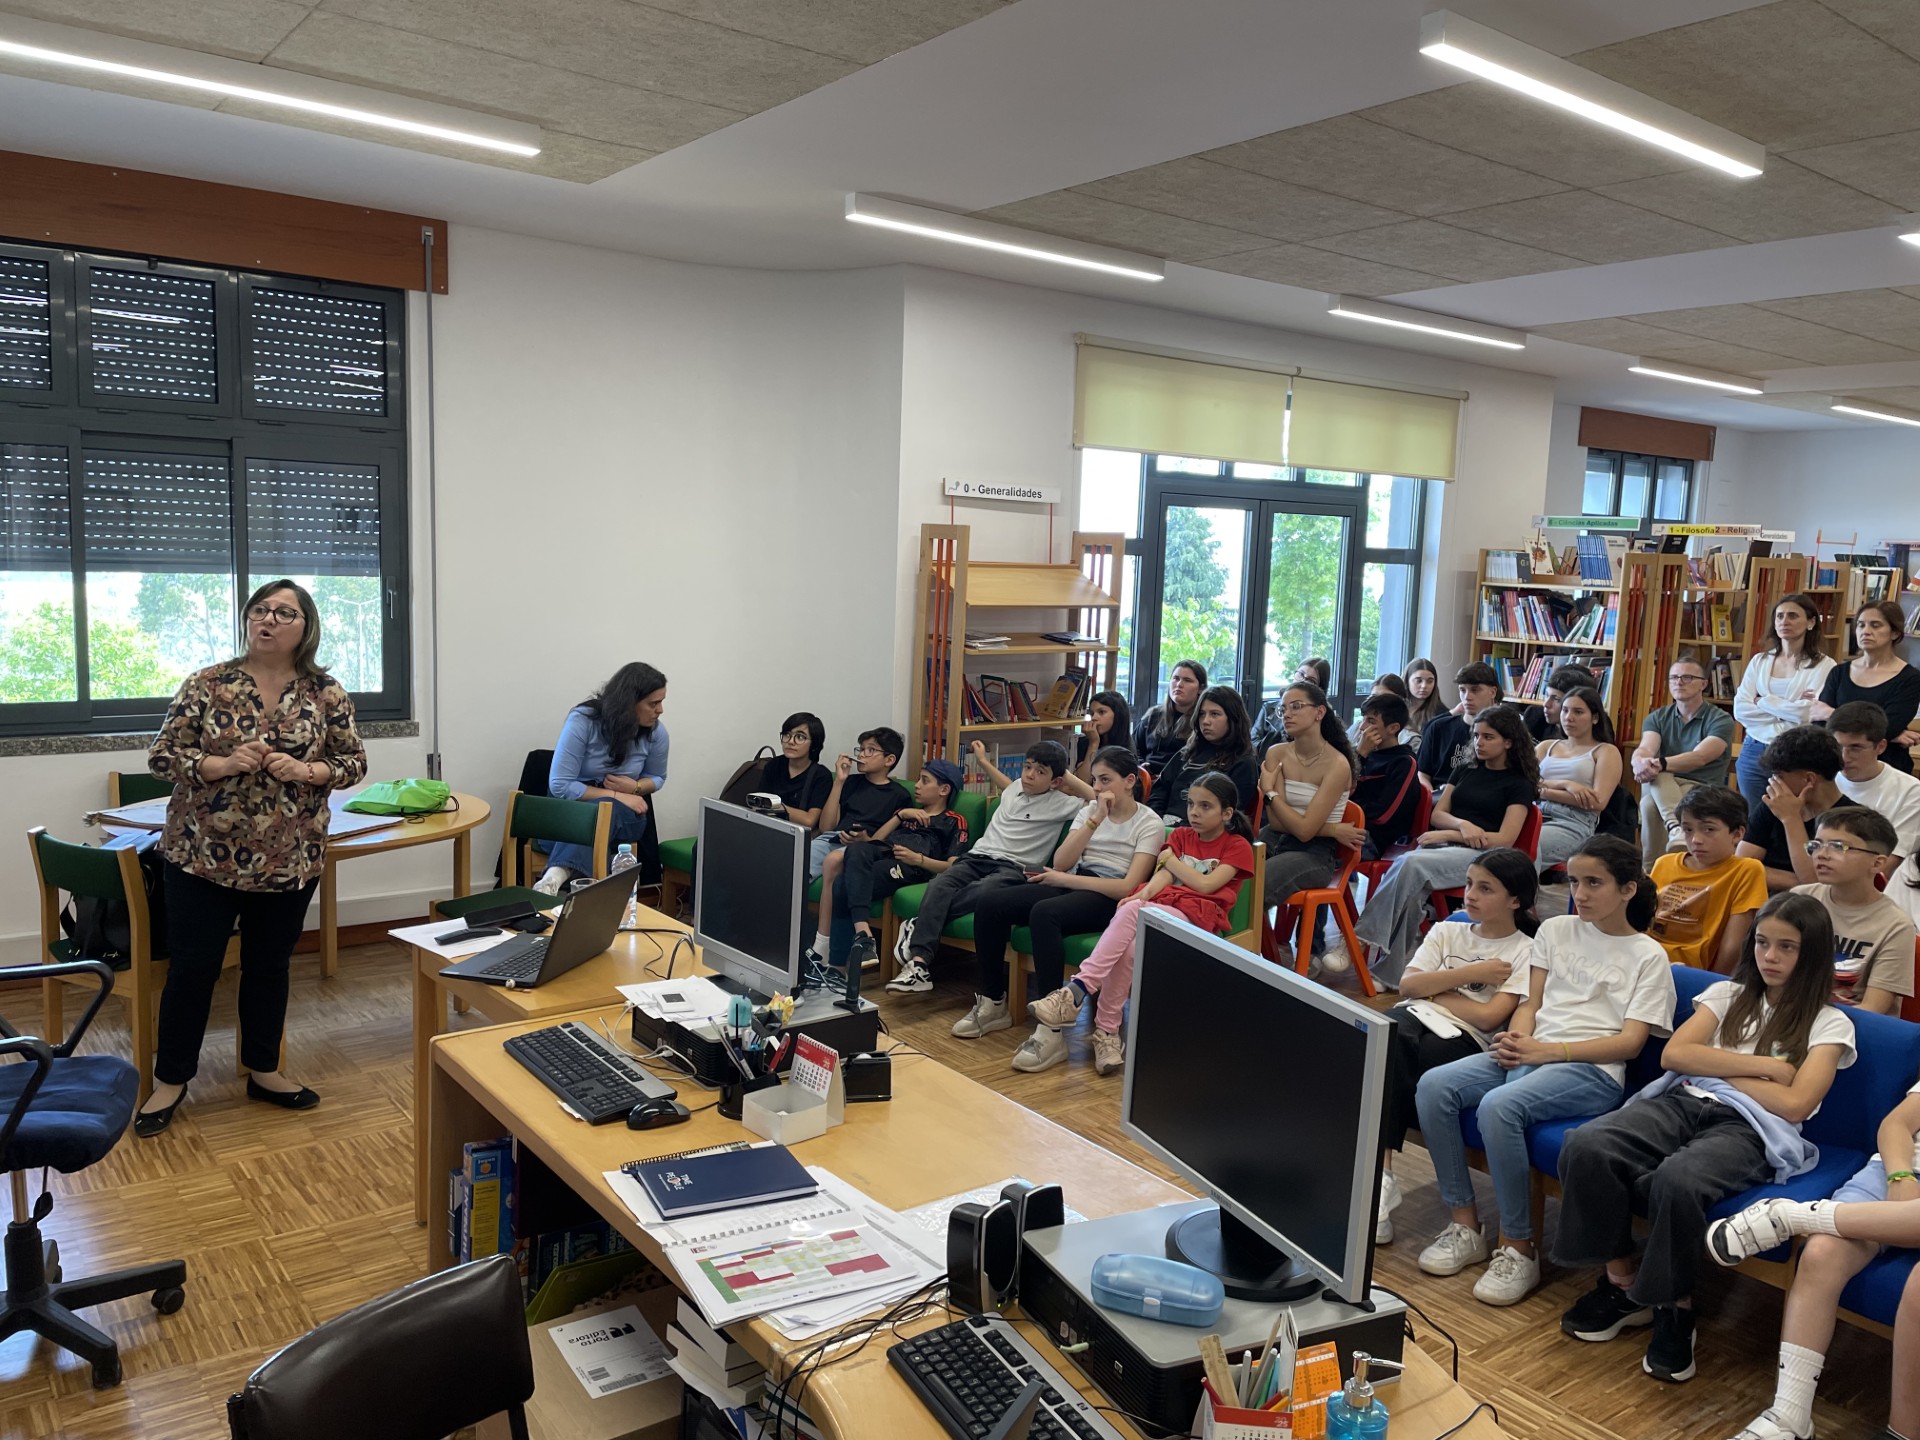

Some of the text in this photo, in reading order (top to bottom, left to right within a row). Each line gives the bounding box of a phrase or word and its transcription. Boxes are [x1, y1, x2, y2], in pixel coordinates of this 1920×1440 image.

[964, 484, 969, 492] 0
[978, 484, 1042, 498] Generalidades
[1728, 526, 1760, 536] Religião
[568, 1330, 606, 1344] Editora
[580, 1336, 610, 1346] Porto
